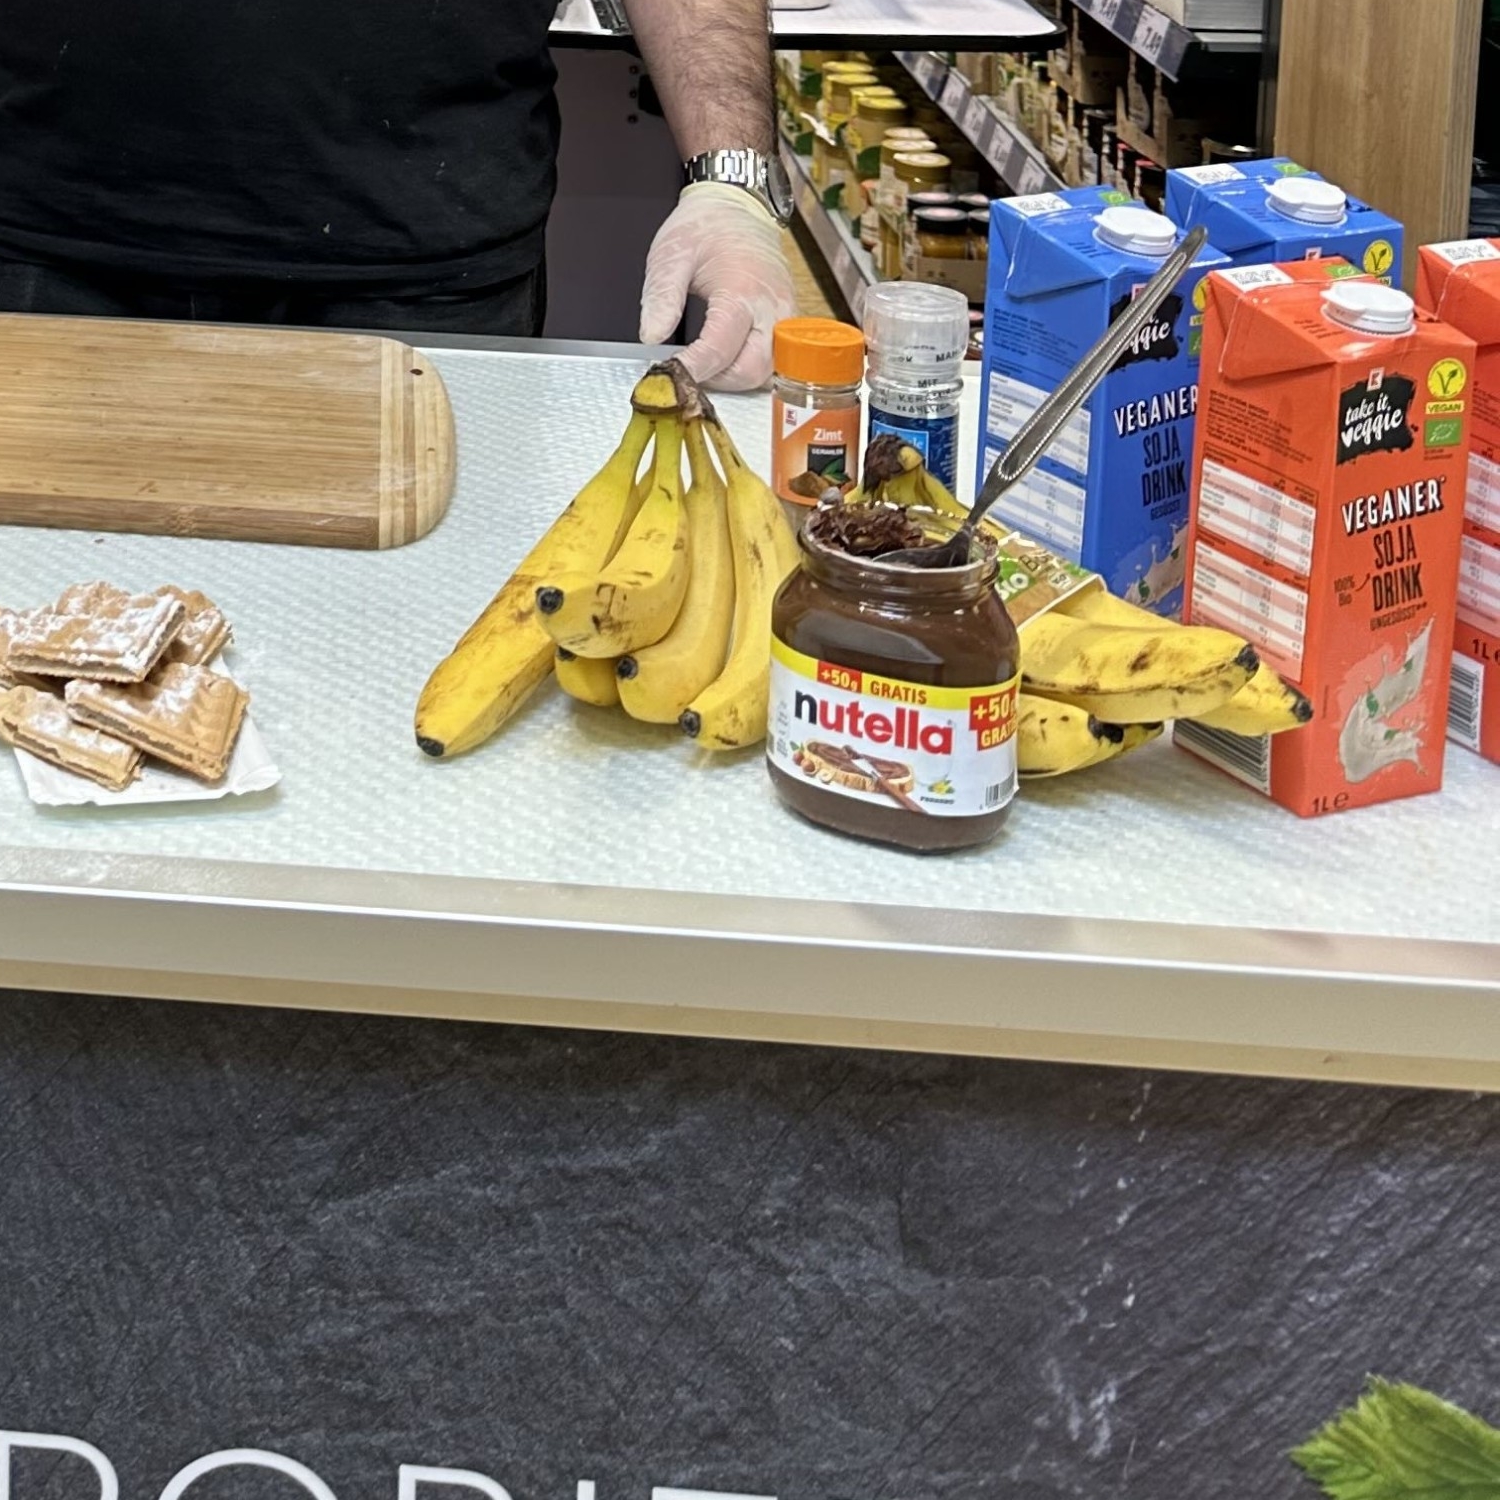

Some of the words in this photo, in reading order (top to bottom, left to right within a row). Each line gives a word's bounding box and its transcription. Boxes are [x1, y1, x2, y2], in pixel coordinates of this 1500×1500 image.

[1113, 384, 1199, 437] VEGANER
[1340, 407, 1404, 448] veggie
[1345, 398, 1375, 426] take
[1376, 391, 1390, 412] it
[1426, 401, 1463, 414] VEGAN
[814, 428, 844, 442] Zimt
[1143, 425, 1181, 468] SOJA
[1141, 460, 1187, 507] DRINK
[1373, 523, 1417, 570] SOJA
[1371, 562, 1424, 612] DRINK
[870, 680, 928, 705] GRATIS
[794, 688, 954, 756] nutella
